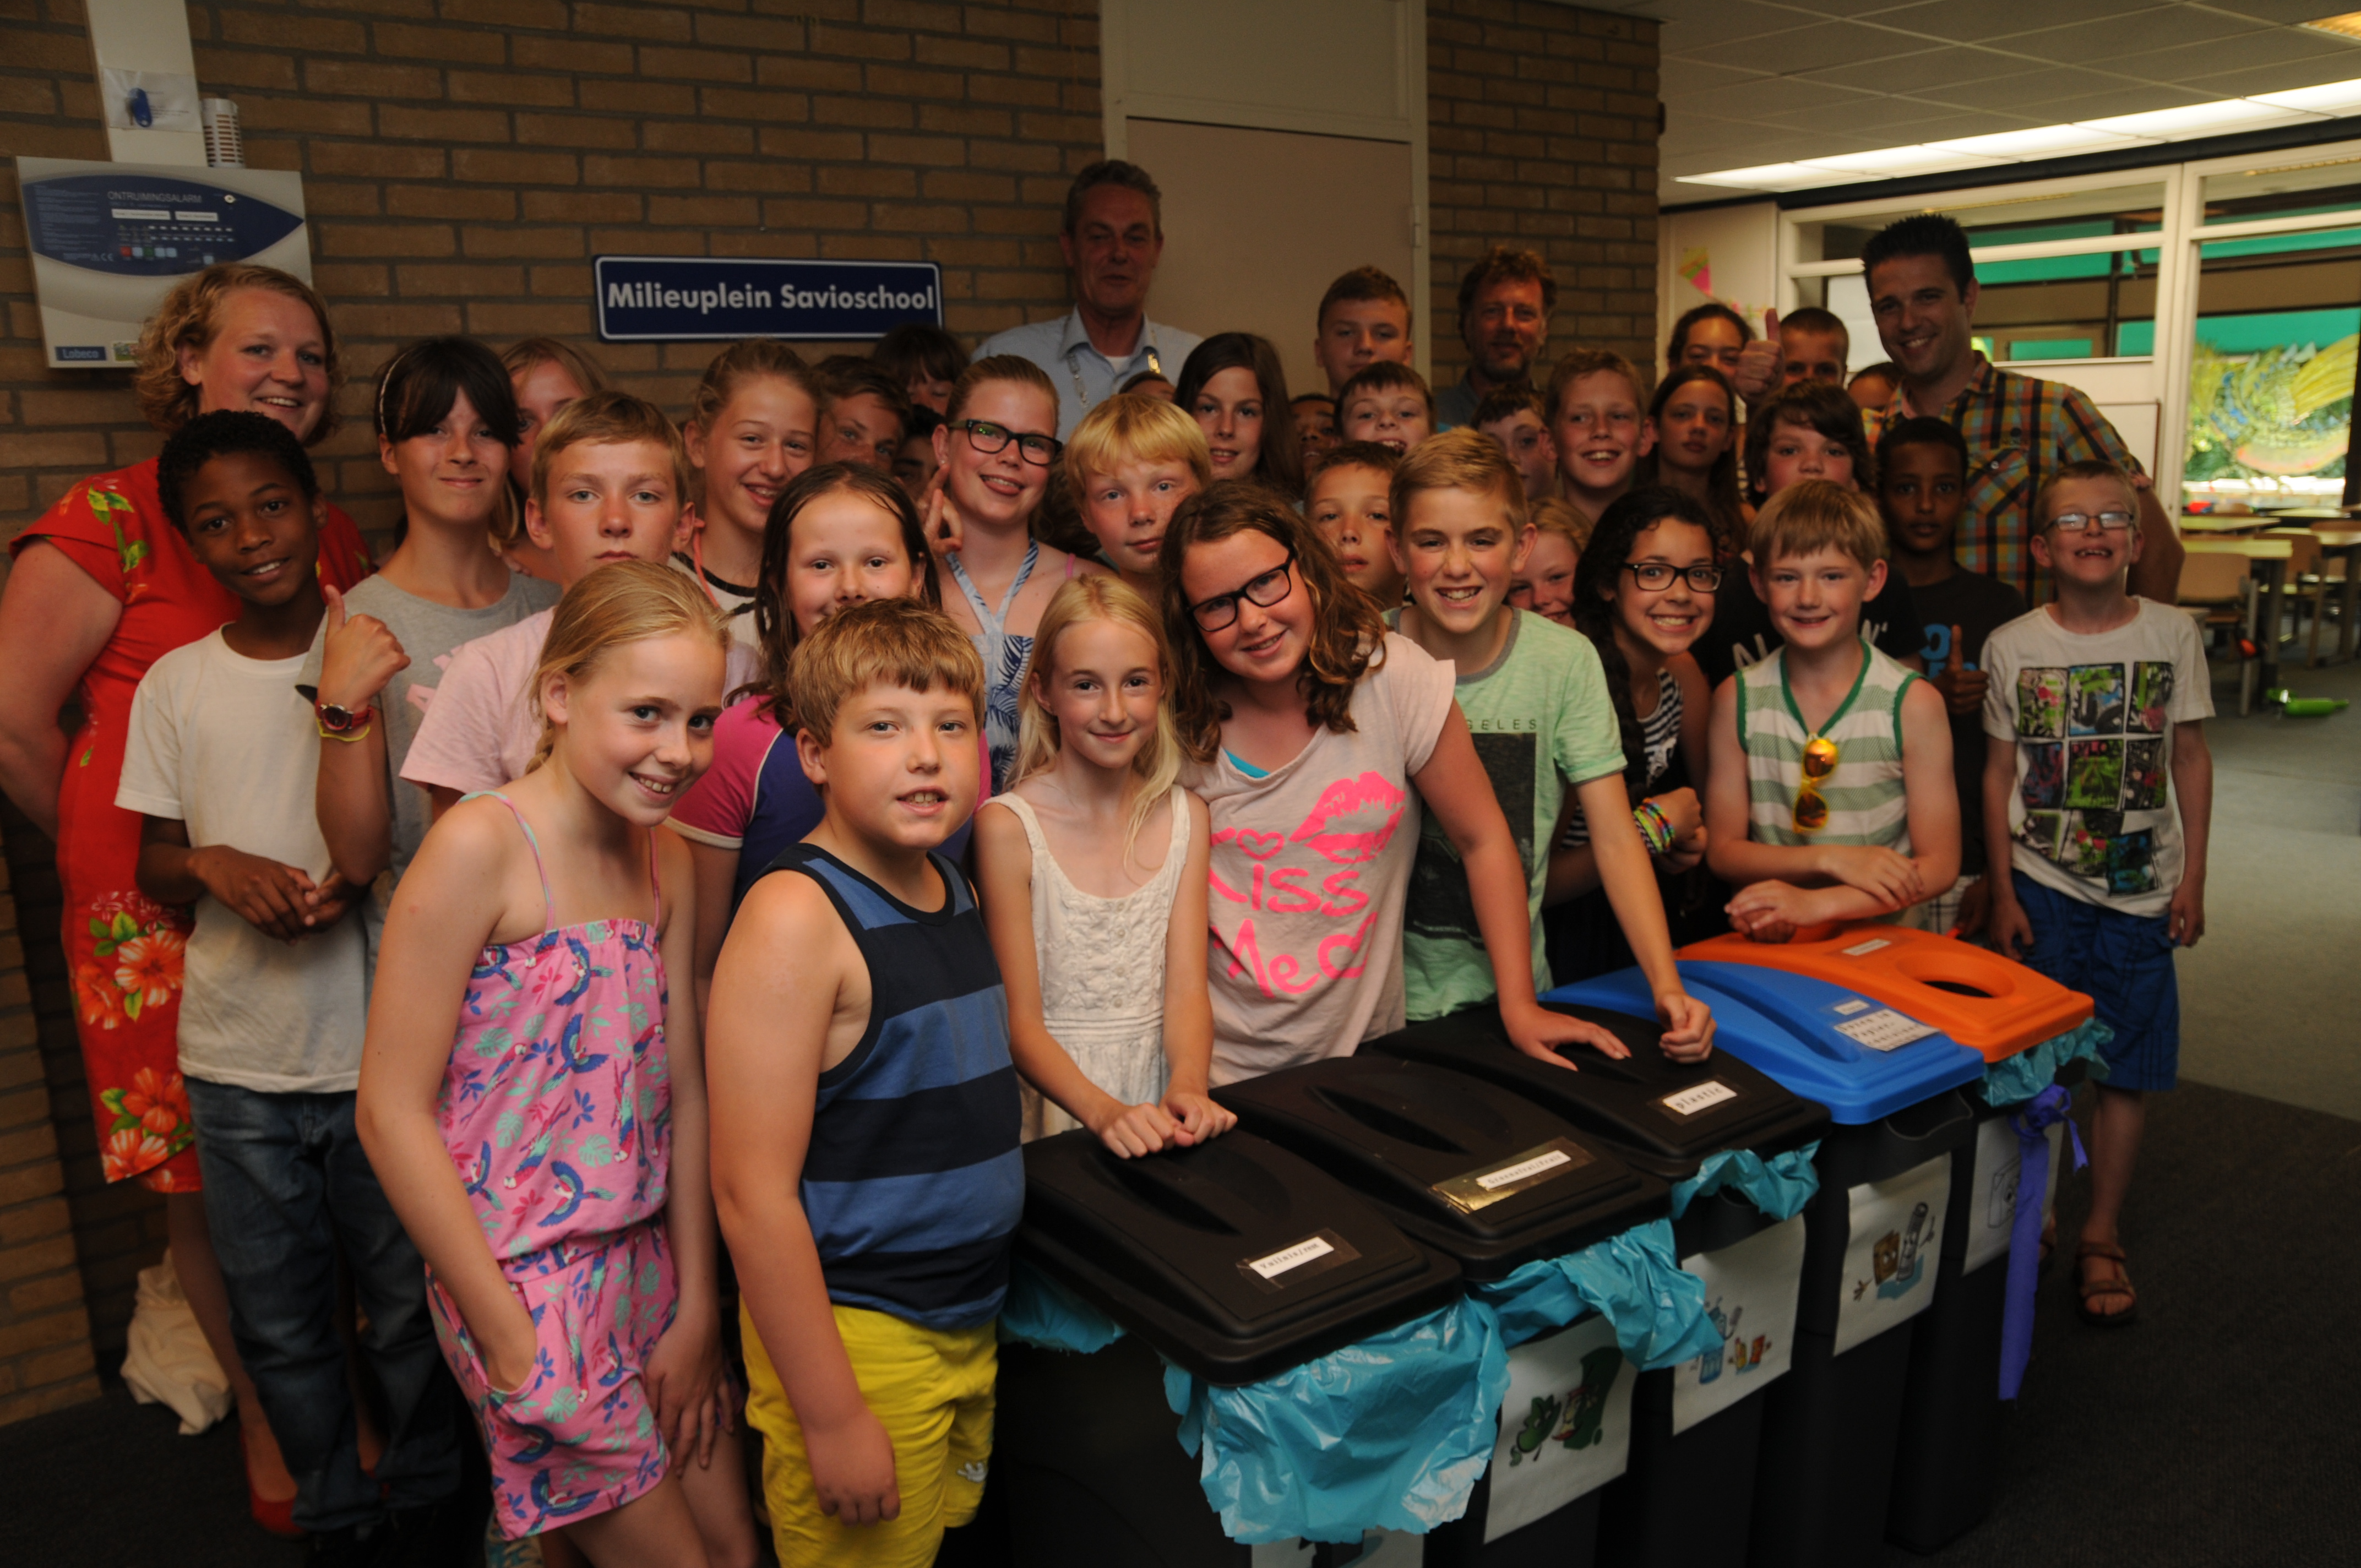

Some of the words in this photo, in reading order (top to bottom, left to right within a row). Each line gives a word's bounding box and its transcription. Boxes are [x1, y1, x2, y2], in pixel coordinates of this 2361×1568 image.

[107, 191, 203, 204] ONTRUIMINGSALARM
[607, 282, 771, 315] Milieuplein
[780, 284, 934, 309] Savioschool
[62, 349, 99, 359] Lobeco
[1466, 718, 1537, 731] GELES
